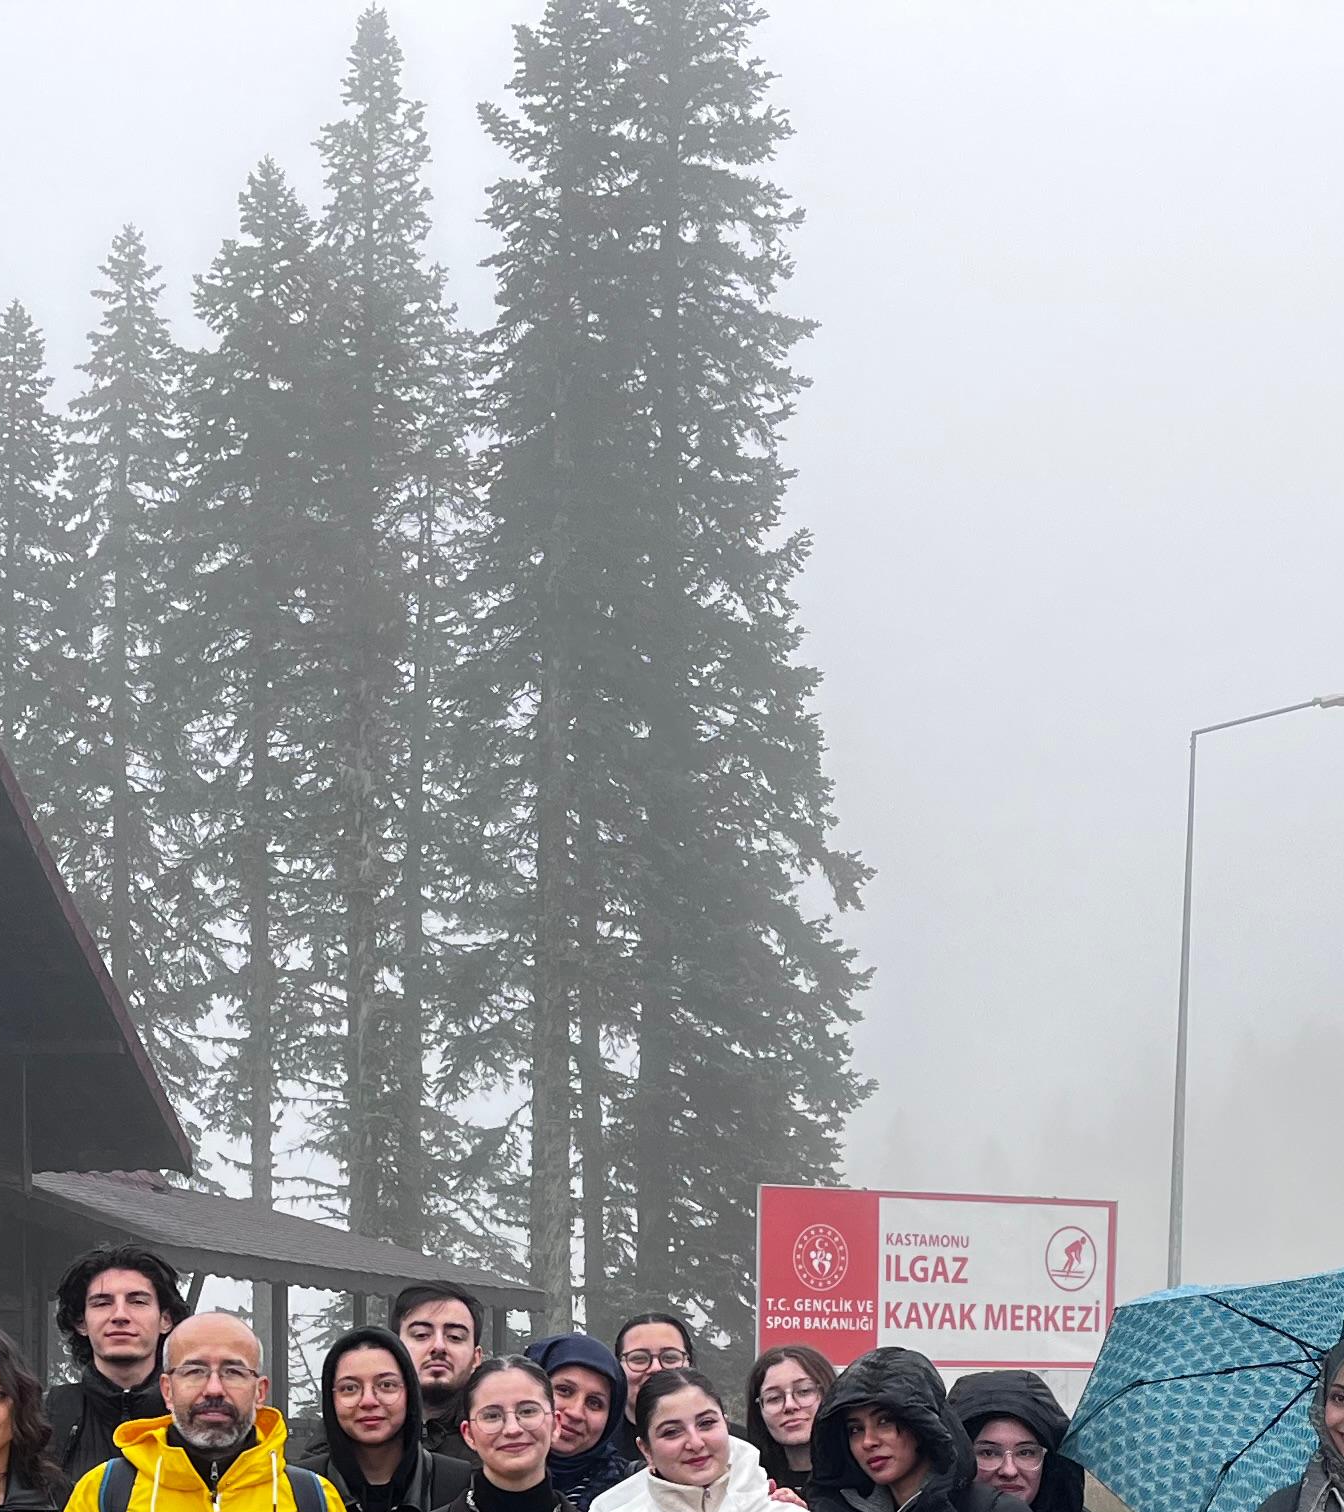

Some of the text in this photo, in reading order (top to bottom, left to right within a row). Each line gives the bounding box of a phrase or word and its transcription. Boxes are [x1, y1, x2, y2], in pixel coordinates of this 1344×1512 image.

[885, 1232, 970, 1249] KASTAMONU
[885, 1254, 969, 1284] ILGAZ
[765, 1296, 874, 1316] T.C. GENÇLİK VE
[884, 1299, 1100, 1332] KAYAK MERKEZİ
[765, 1315, 874, 1331] SPOR BAKANLIĞI
